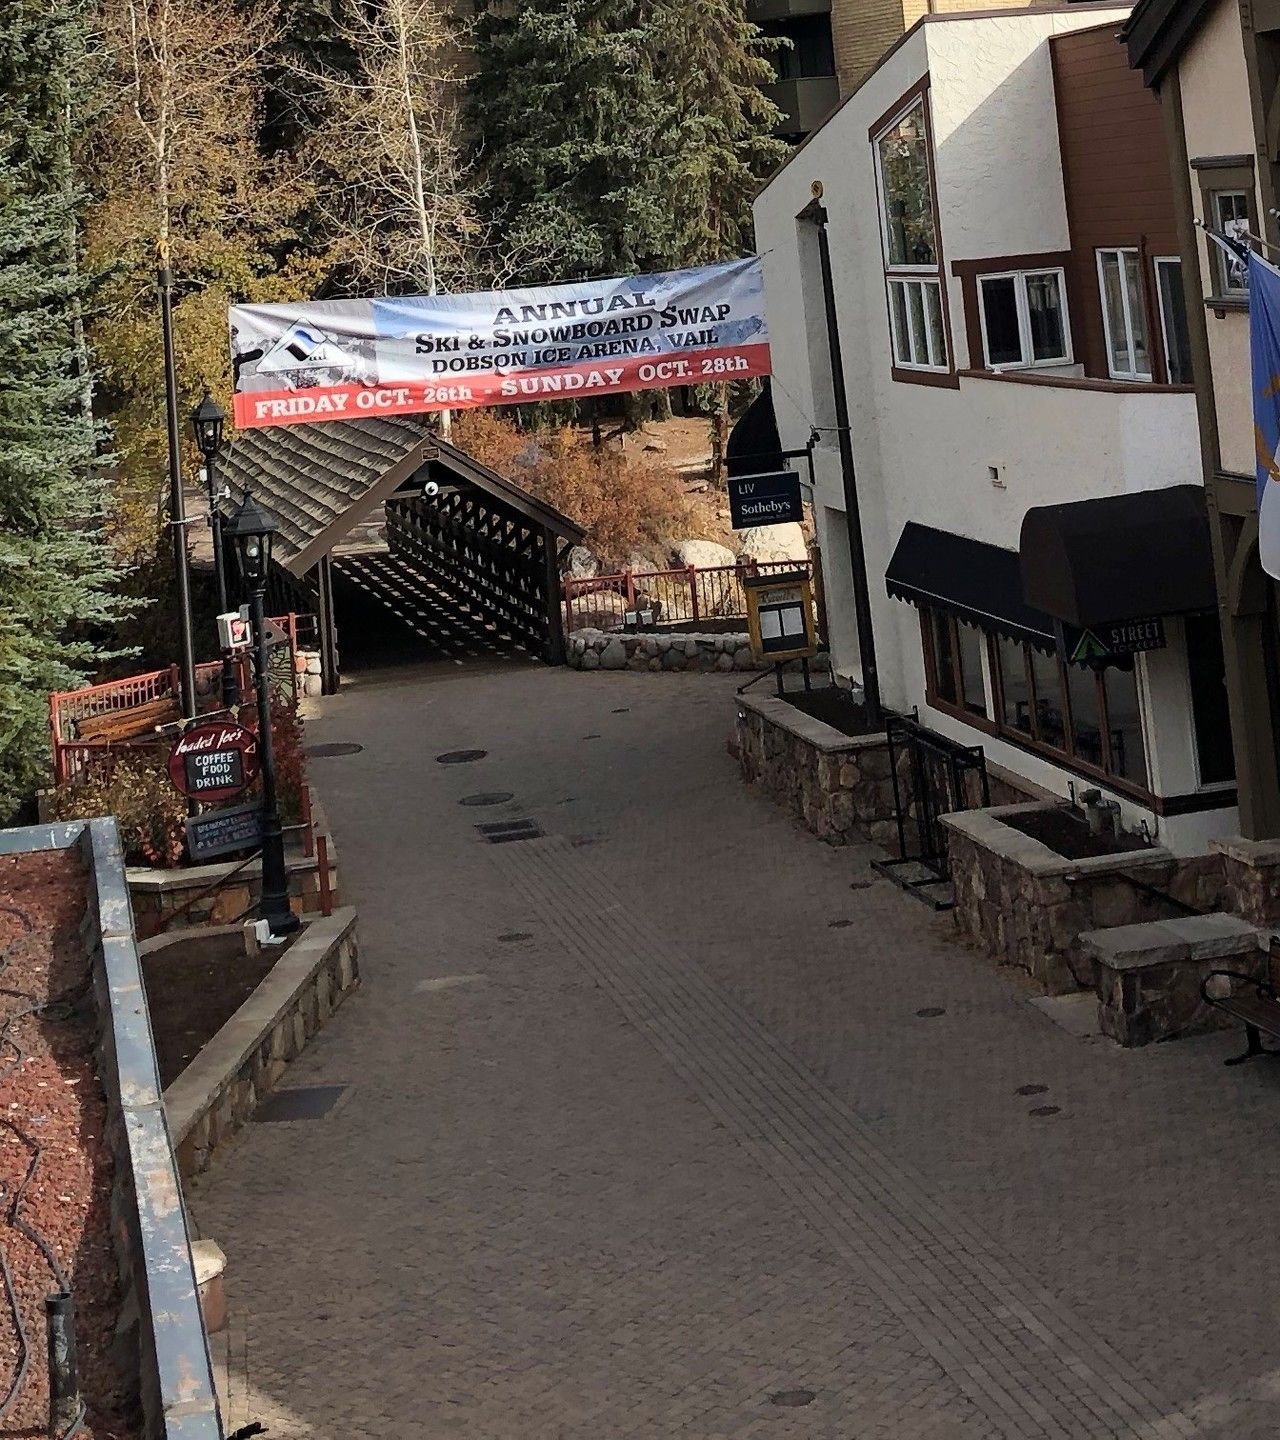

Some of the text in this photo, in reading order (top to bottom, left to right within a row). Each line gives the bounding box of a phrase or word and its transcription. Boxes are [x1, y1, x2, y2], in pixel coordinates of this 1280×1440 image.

[492, 291, 656, 326] ANNUAL
[415, 303, 731, 355] SKI & SNOWBOARD SWAP
[432, 327, 719, 374] DOBSON ICE ARENA, VAIL
[255, 393, 349, 419] FRIDAY
[356, 388, 414, 410] OCT.
[423, 385, 472, 404] 26th
[501, 368, 624, 396] SUNDAY
[638, 359, 693, 382] OCT.
[701, 355, 749, 374] 28th
[738, 483, 755, 495] LIV
[741, 500, 791, 515] Sotheby's
[1111, 622, 1159, 644] STREET
[195, 752, 234, 767] COFFEE
[202, 764, 231, 776] FOOD
[196, 775, 234, 789] DRINK
